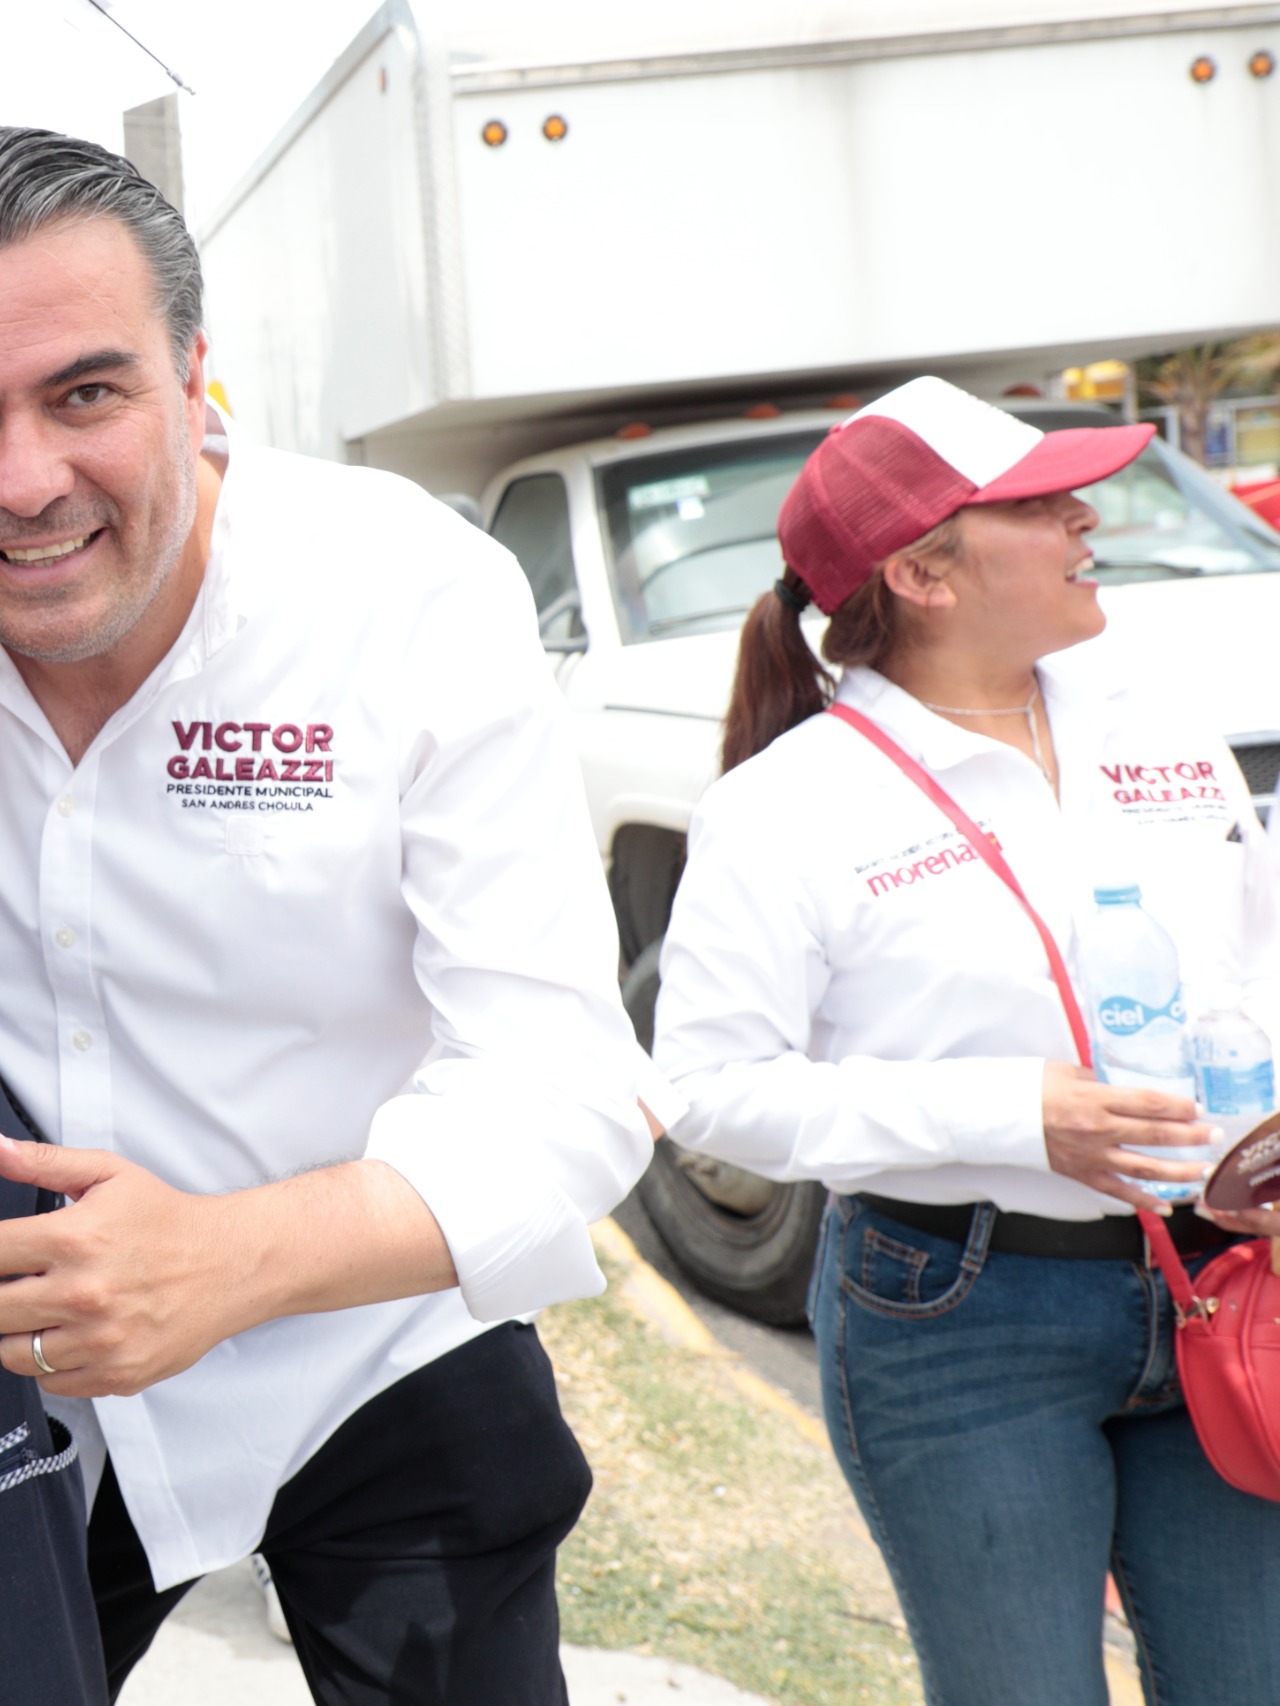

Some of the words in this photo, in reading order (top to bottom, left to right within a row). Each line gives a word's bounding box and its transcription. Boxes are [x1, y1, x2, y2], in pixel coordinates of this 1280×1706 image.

[171, 721, 334, 753] VICTOR
[167, 755, 334, 782] GALEAZZI
[1099, 761, 1218, 785] VICTOR
[166, 784, 252, 797] PRESIDENTE
[255, 786, 333, 799] MUNICIPAL
[181, 798, 206, 809] SAN
[209, 800, 255, 810] ANDRES
[258, 801, 314, 811] CHOLULA
[866, 843, 978, 897] morena
[1100, 1003, 1144, 1027] ciel
